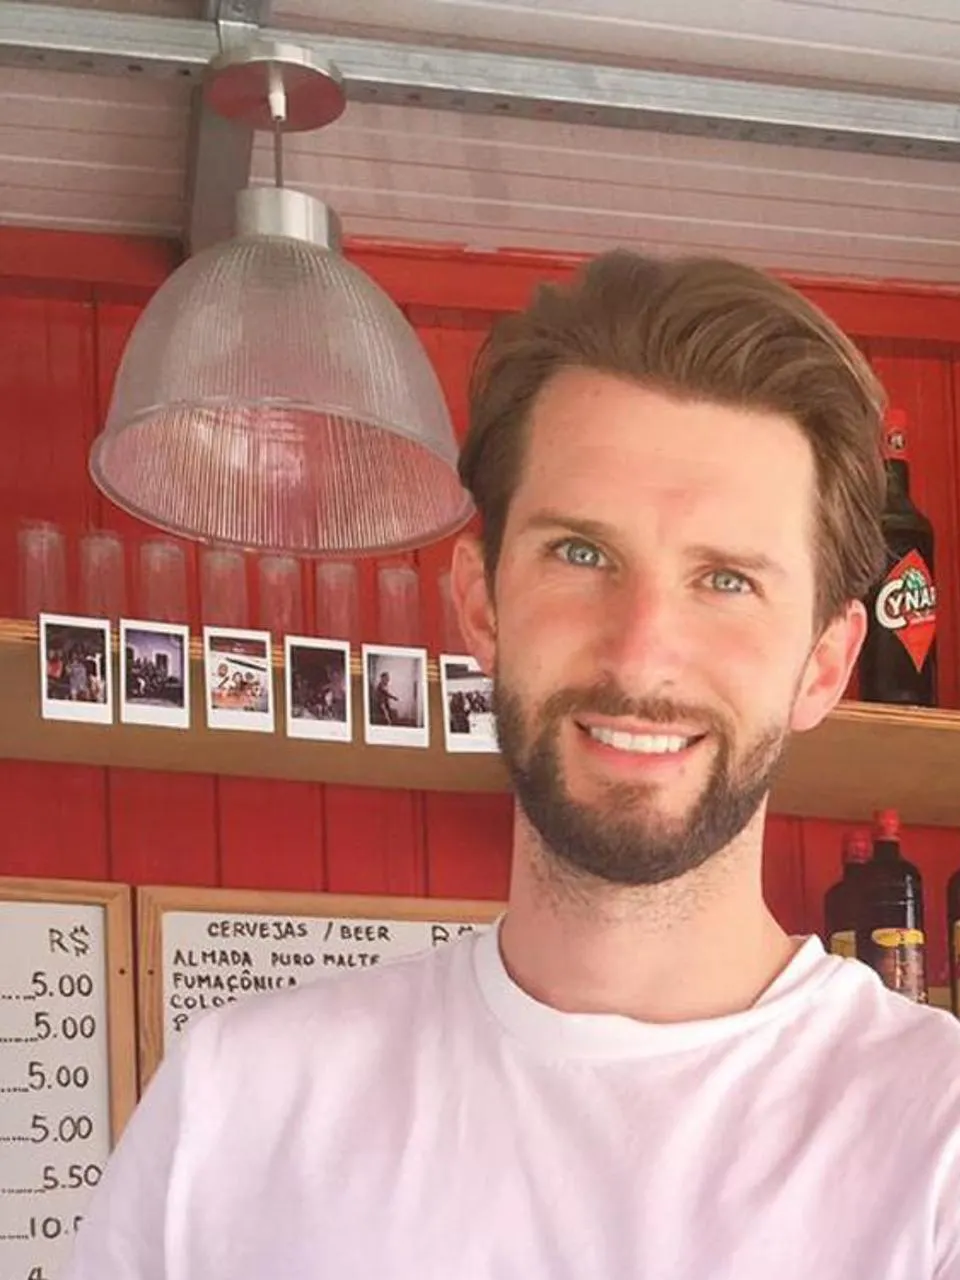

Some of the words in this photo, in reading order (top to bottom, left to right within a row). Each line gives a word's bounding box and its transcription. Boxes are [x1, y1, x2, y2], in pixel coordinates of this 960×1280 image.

[49, 926, 90, 957] R$
[207, 921, 308, 939] CERVEJAS
[340, 925, 392, 942] BEER
[173, 949, 254, 967] ALMADA
[271, 951, 315, 967] PURO
[32, 971, 93, 997] 5.00
[34, 1012, 96, 1040] 5.00
[28, 1061, 89, 1090] 5.00
[31, 1115, 93, 1144] 5.00
[43, 1164, 103, 1190] 5.50
